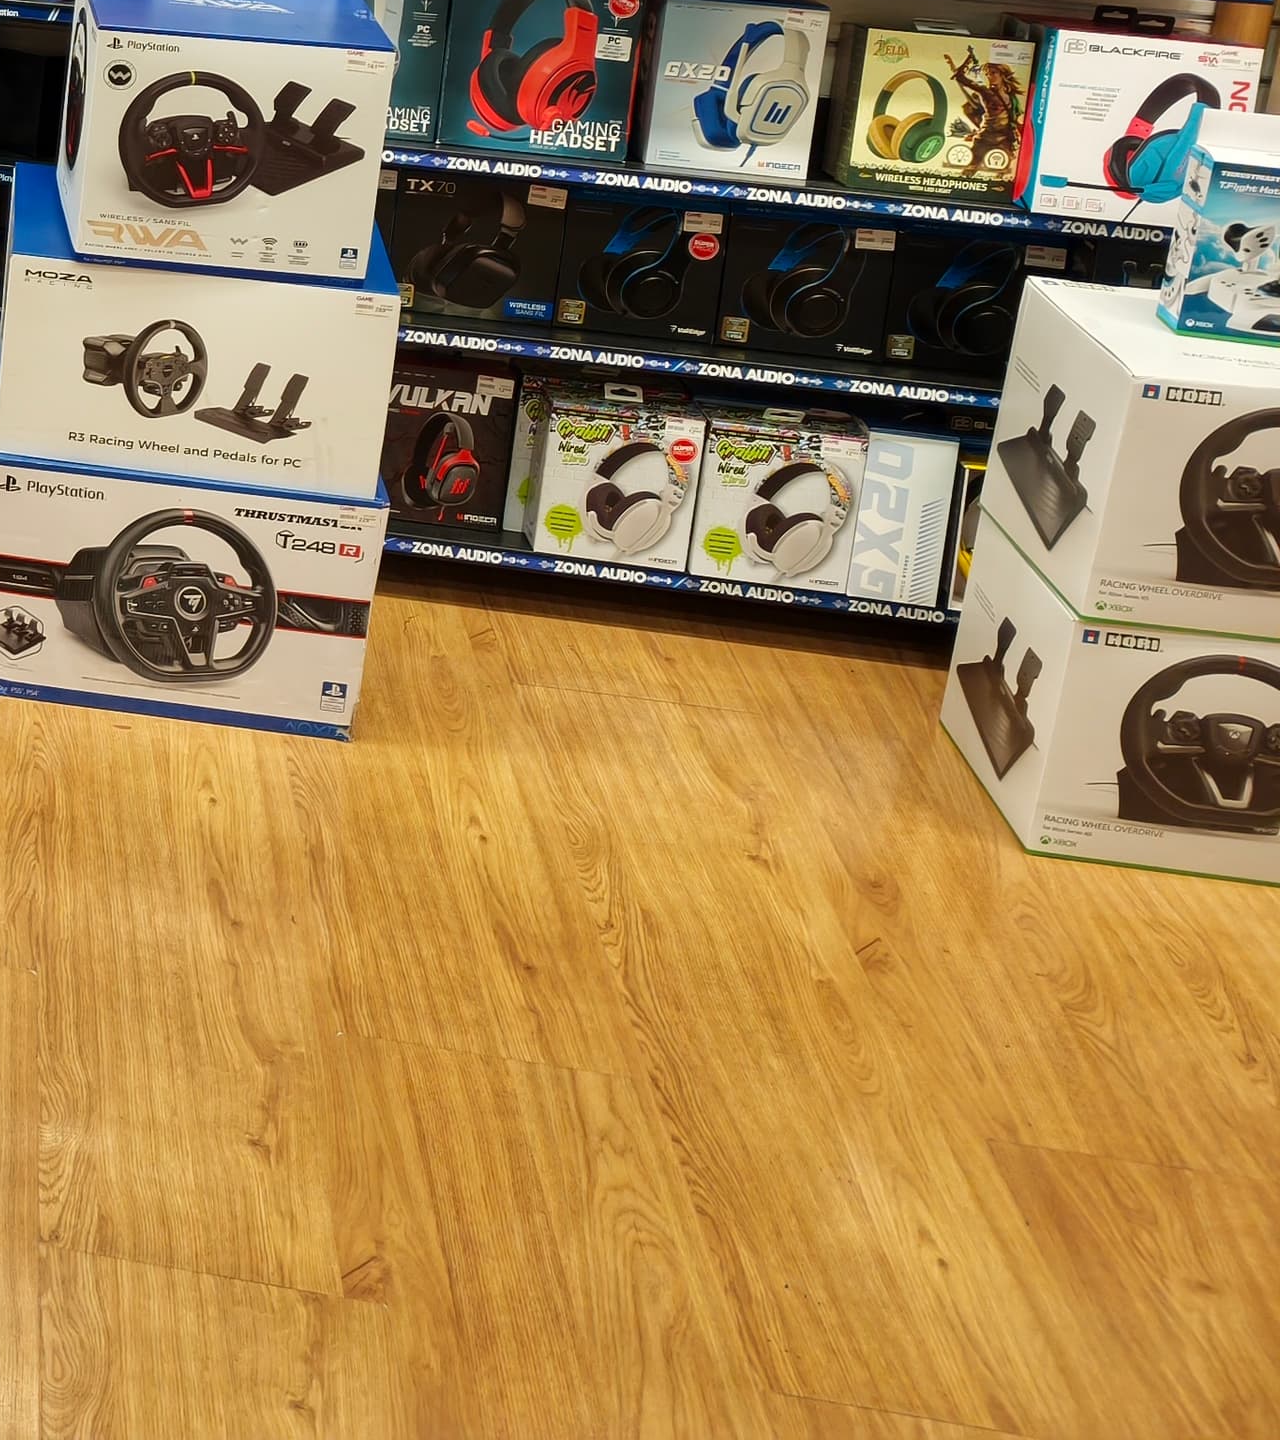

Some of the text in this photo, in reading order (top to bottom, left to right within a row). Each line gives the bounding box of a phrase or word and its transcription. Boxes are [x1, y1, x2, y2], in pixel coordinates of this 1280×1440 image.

[551, 119, 620, 139] GAMING
[530, 131, 619, 153] HEADSET
[747, 189, 845, 210] ZONA AUDIO
[25, 269, 93, 284] MOZA
[68, 431, 301, 469] R3 Racing Wheel and Pedals for PC
[27, 479, 105, 501] PlayStation
[555, 561, 645, 585] ZONA AUDIO
